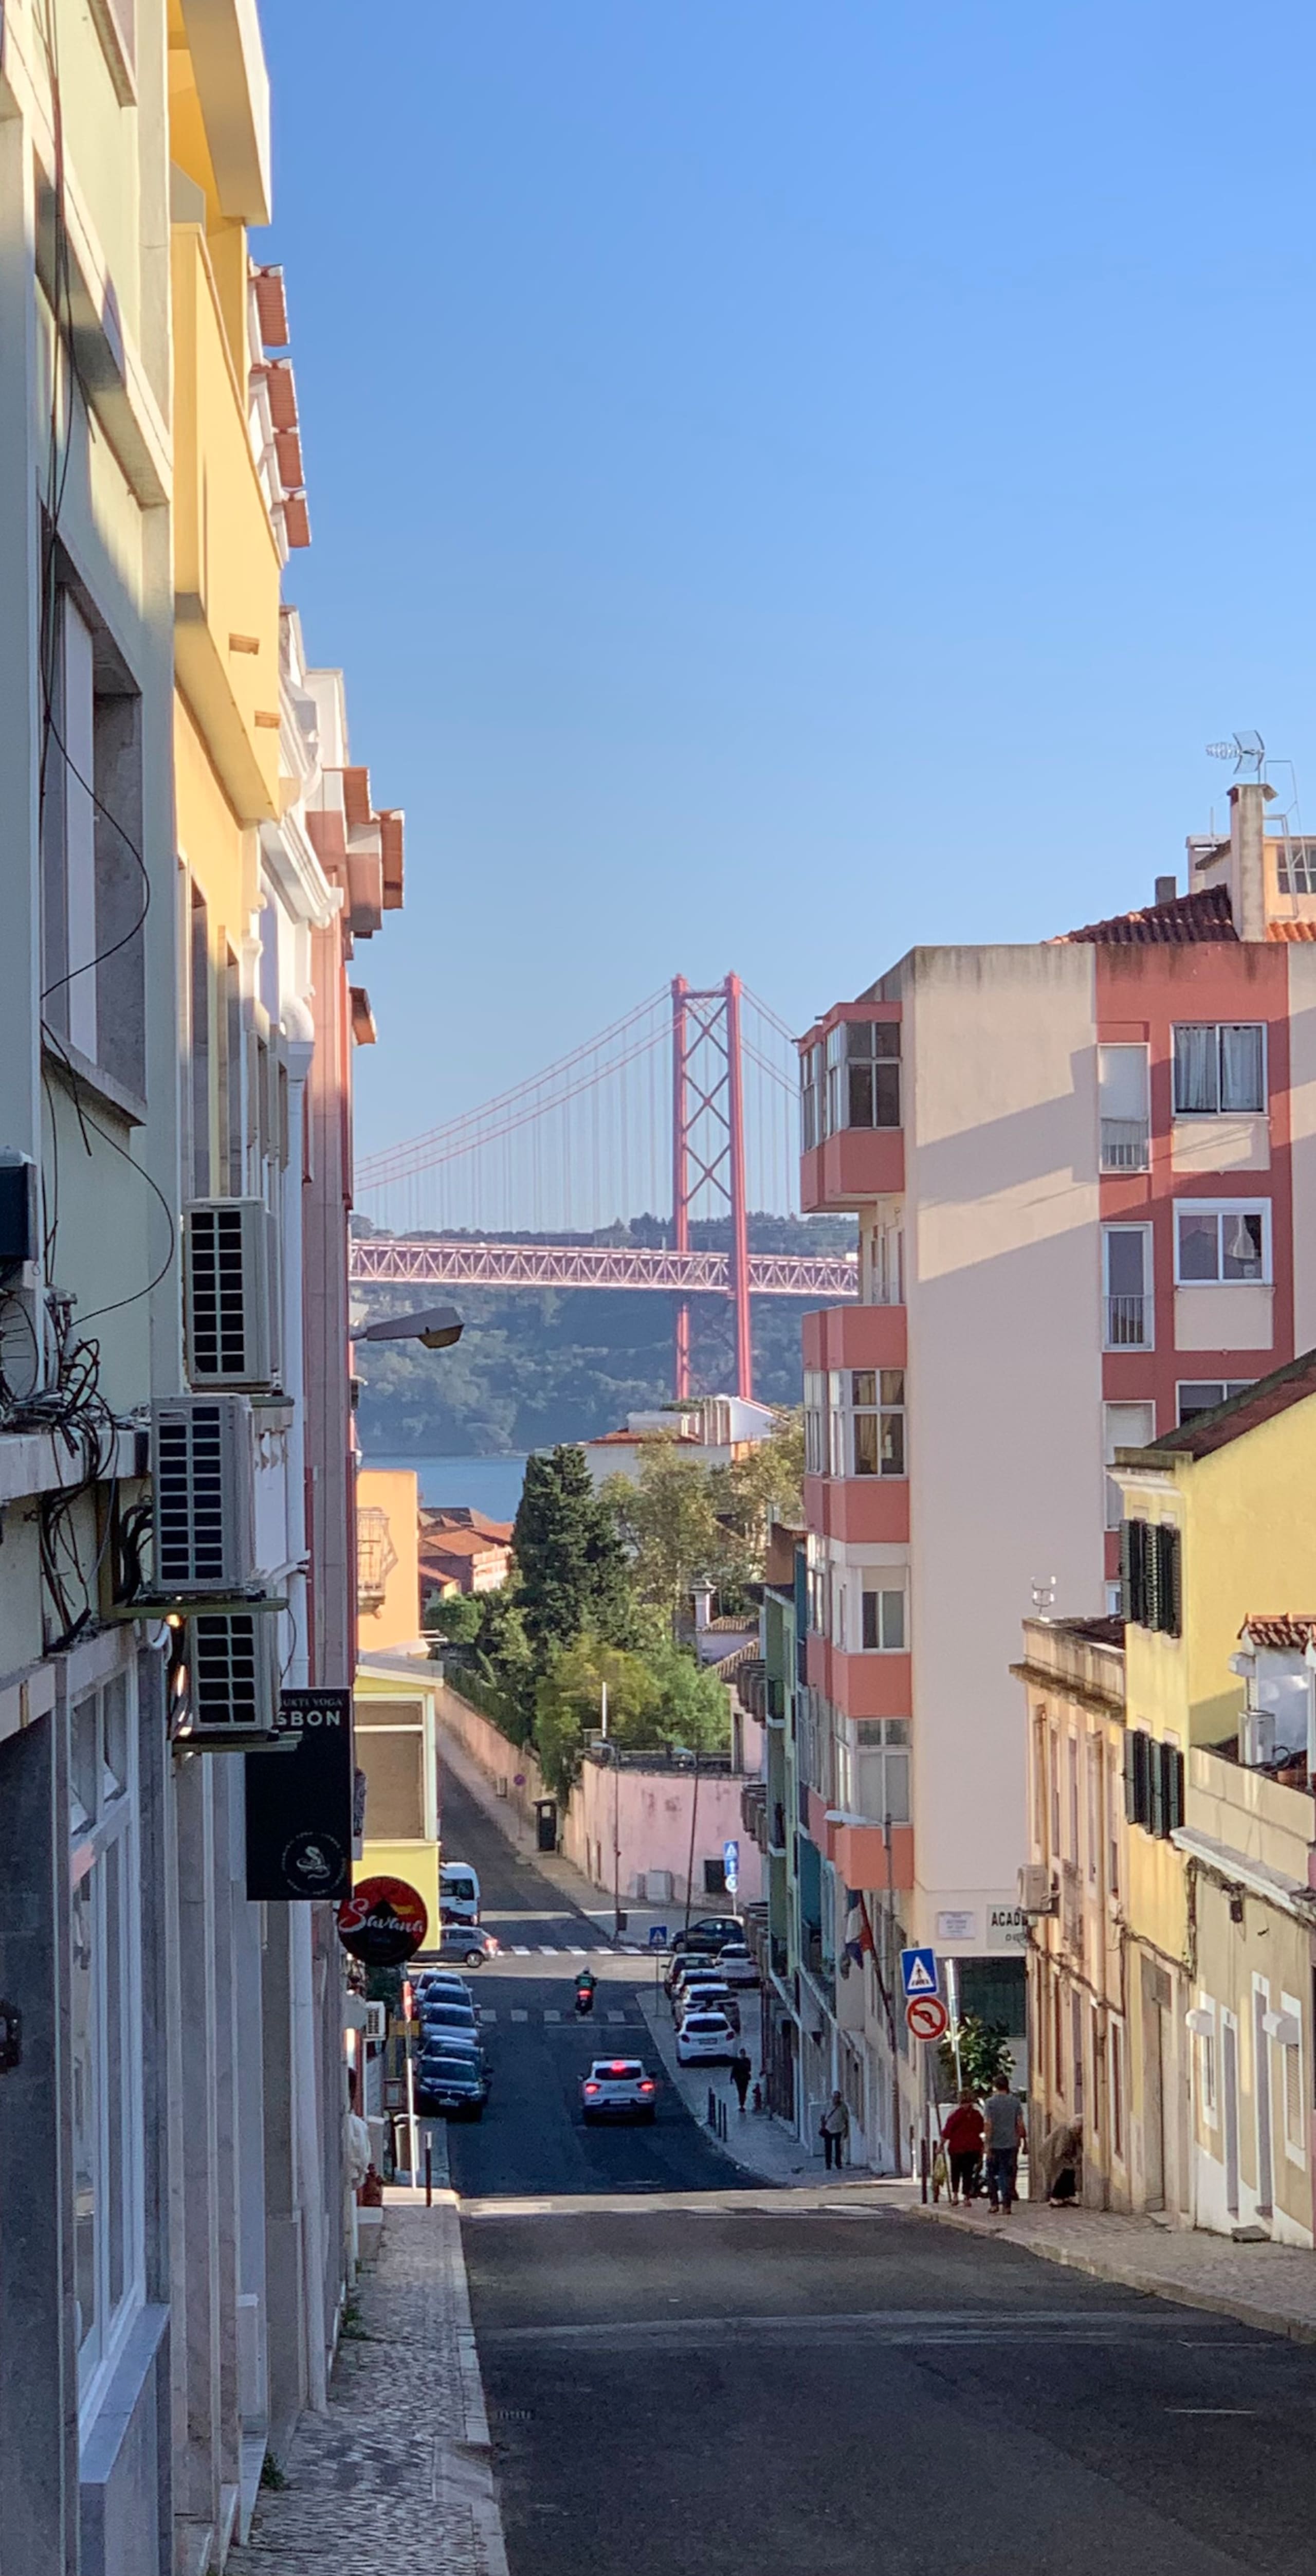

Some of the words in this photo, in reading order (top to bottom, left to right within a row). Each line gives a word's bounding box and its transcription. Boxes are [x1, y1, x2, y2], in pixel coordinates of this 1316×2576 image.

[283, 1698, 308, 1707] UKTI
[312, 1698, 342, 1707] YOGA
[277, 1711, 340, 1726] SBON
[339, 1898, 423, 1933] Savana
